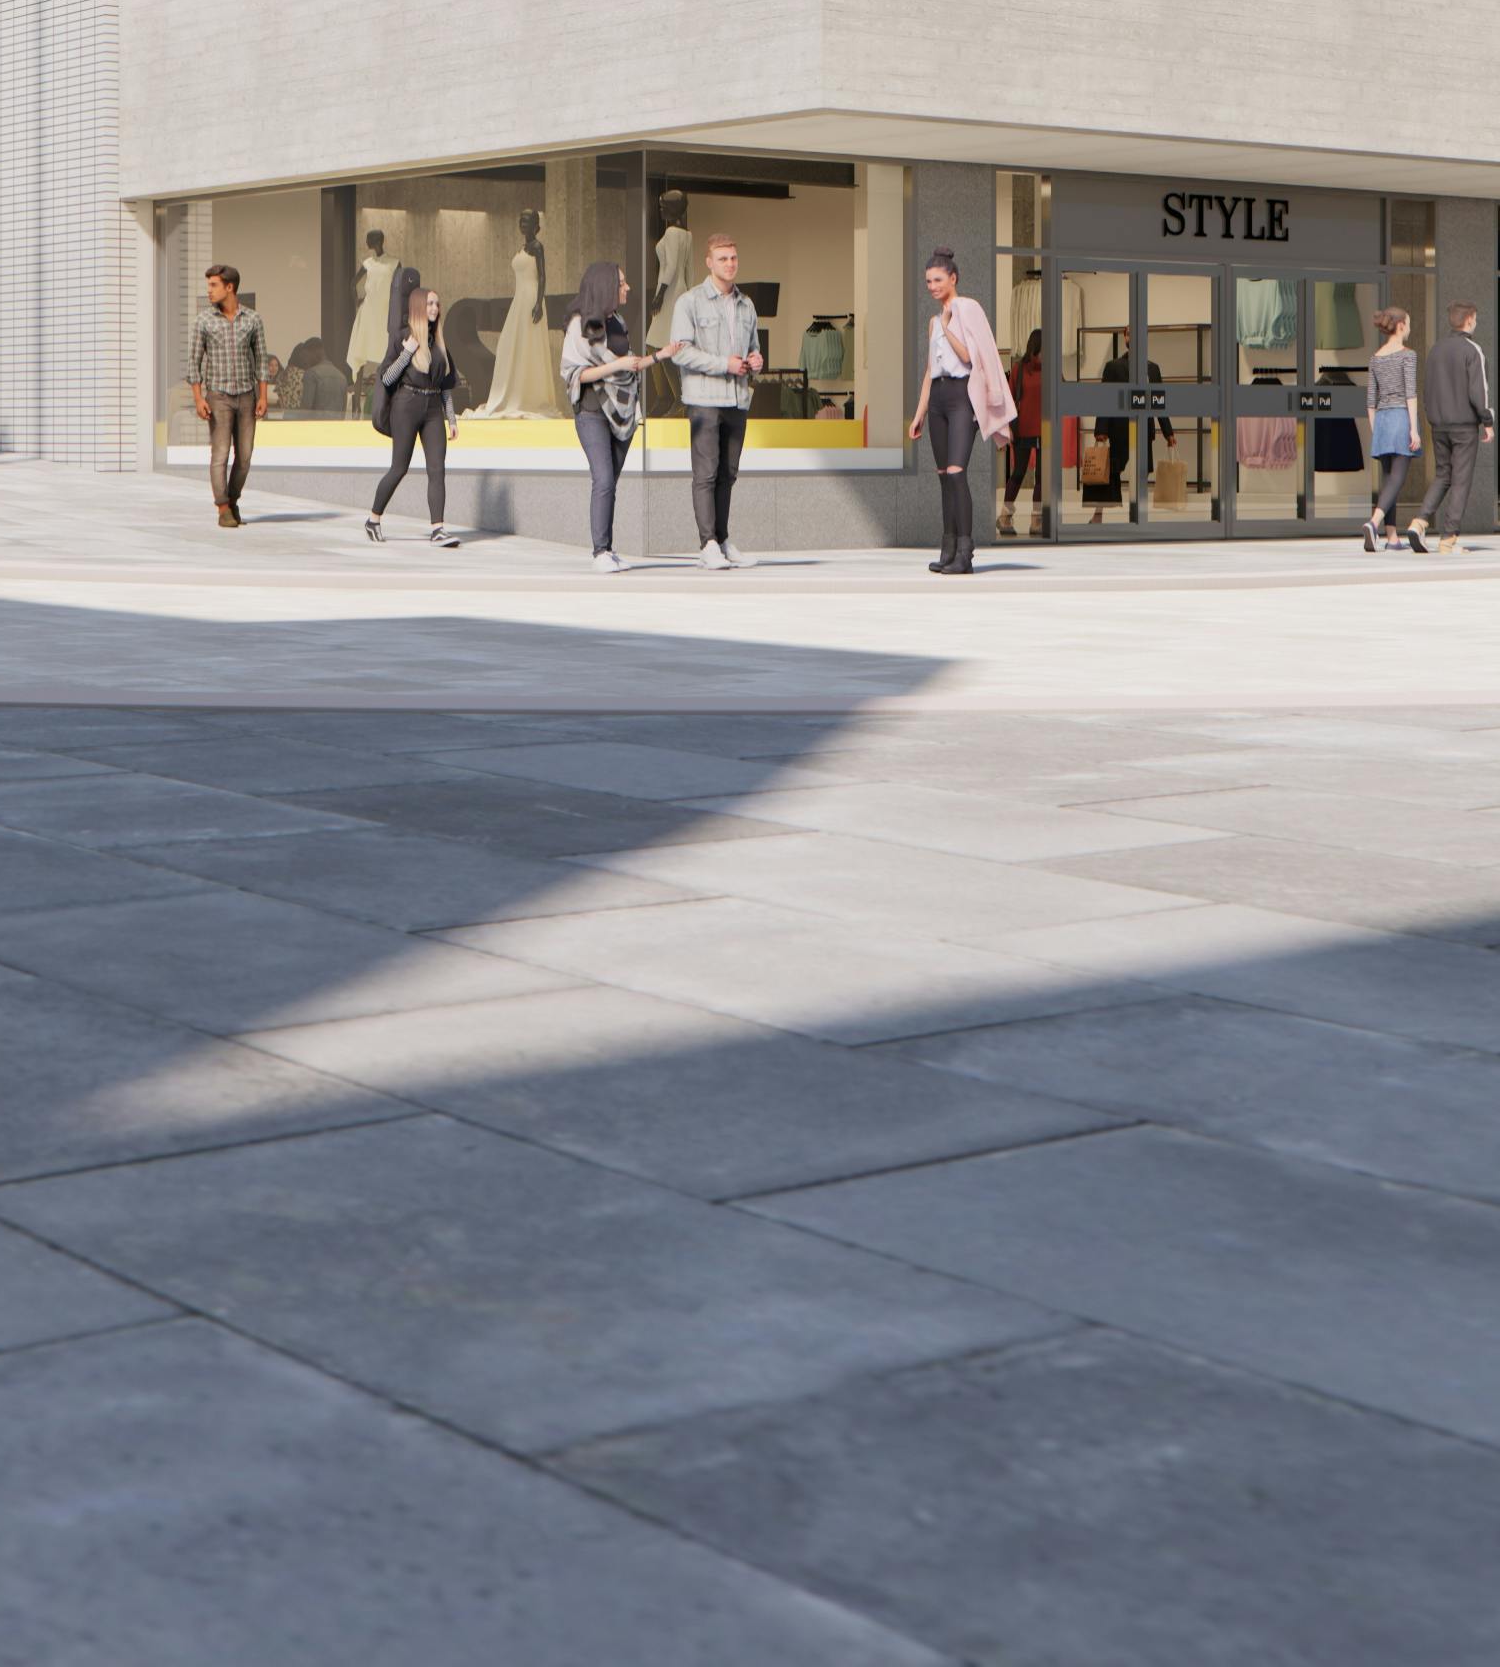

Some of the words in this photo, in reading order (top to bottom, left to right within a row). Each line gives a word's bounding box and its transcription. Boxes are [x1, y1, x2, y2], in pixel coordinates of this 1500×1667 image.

[1163, 192, 1289, 241] STYLE
[1132, 395, 1145, 404] Pull
[1152, 395, 1165, 405] Pull
